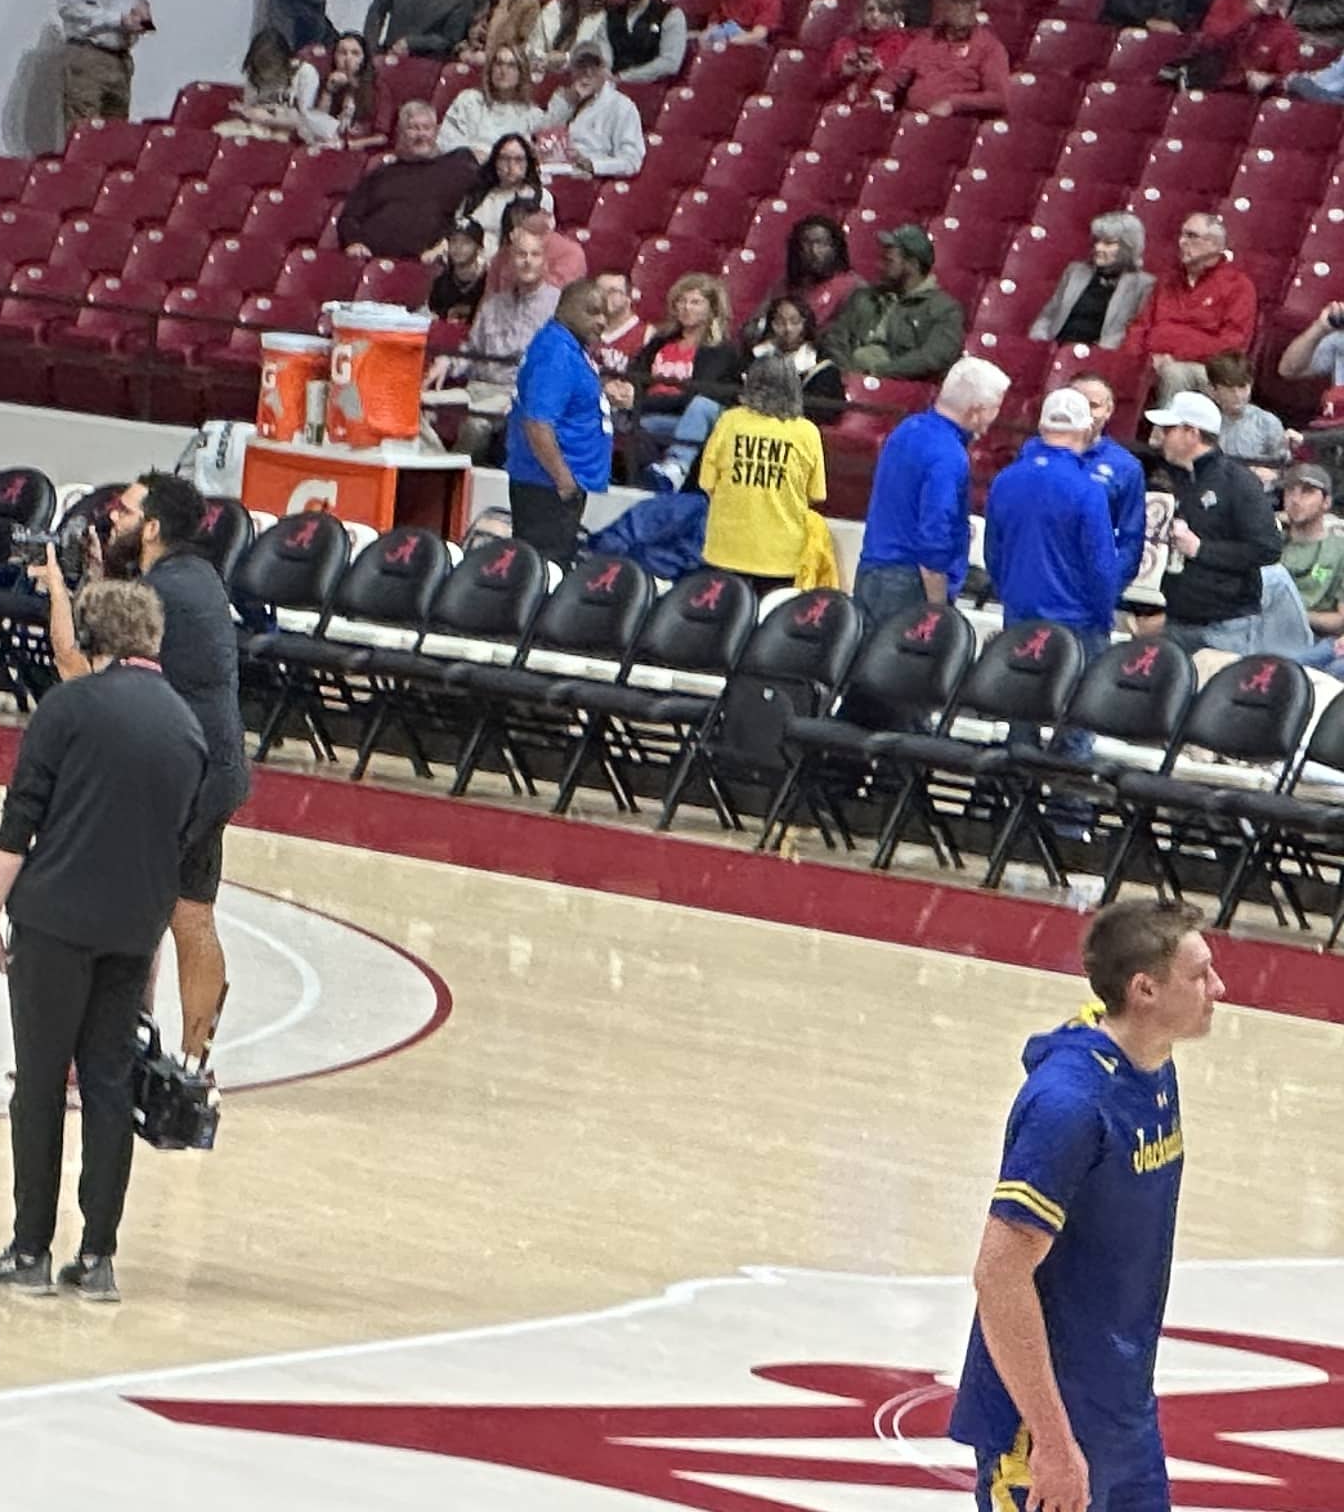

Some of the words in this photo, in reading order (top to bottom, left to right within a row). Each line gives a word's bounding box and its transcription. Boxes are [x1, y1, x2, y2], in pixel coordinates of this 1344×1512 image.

[331, 344, 353, 383] G
[733, 433, 794, 462] EVENT
[731, 459, 787, 491] STAFF
